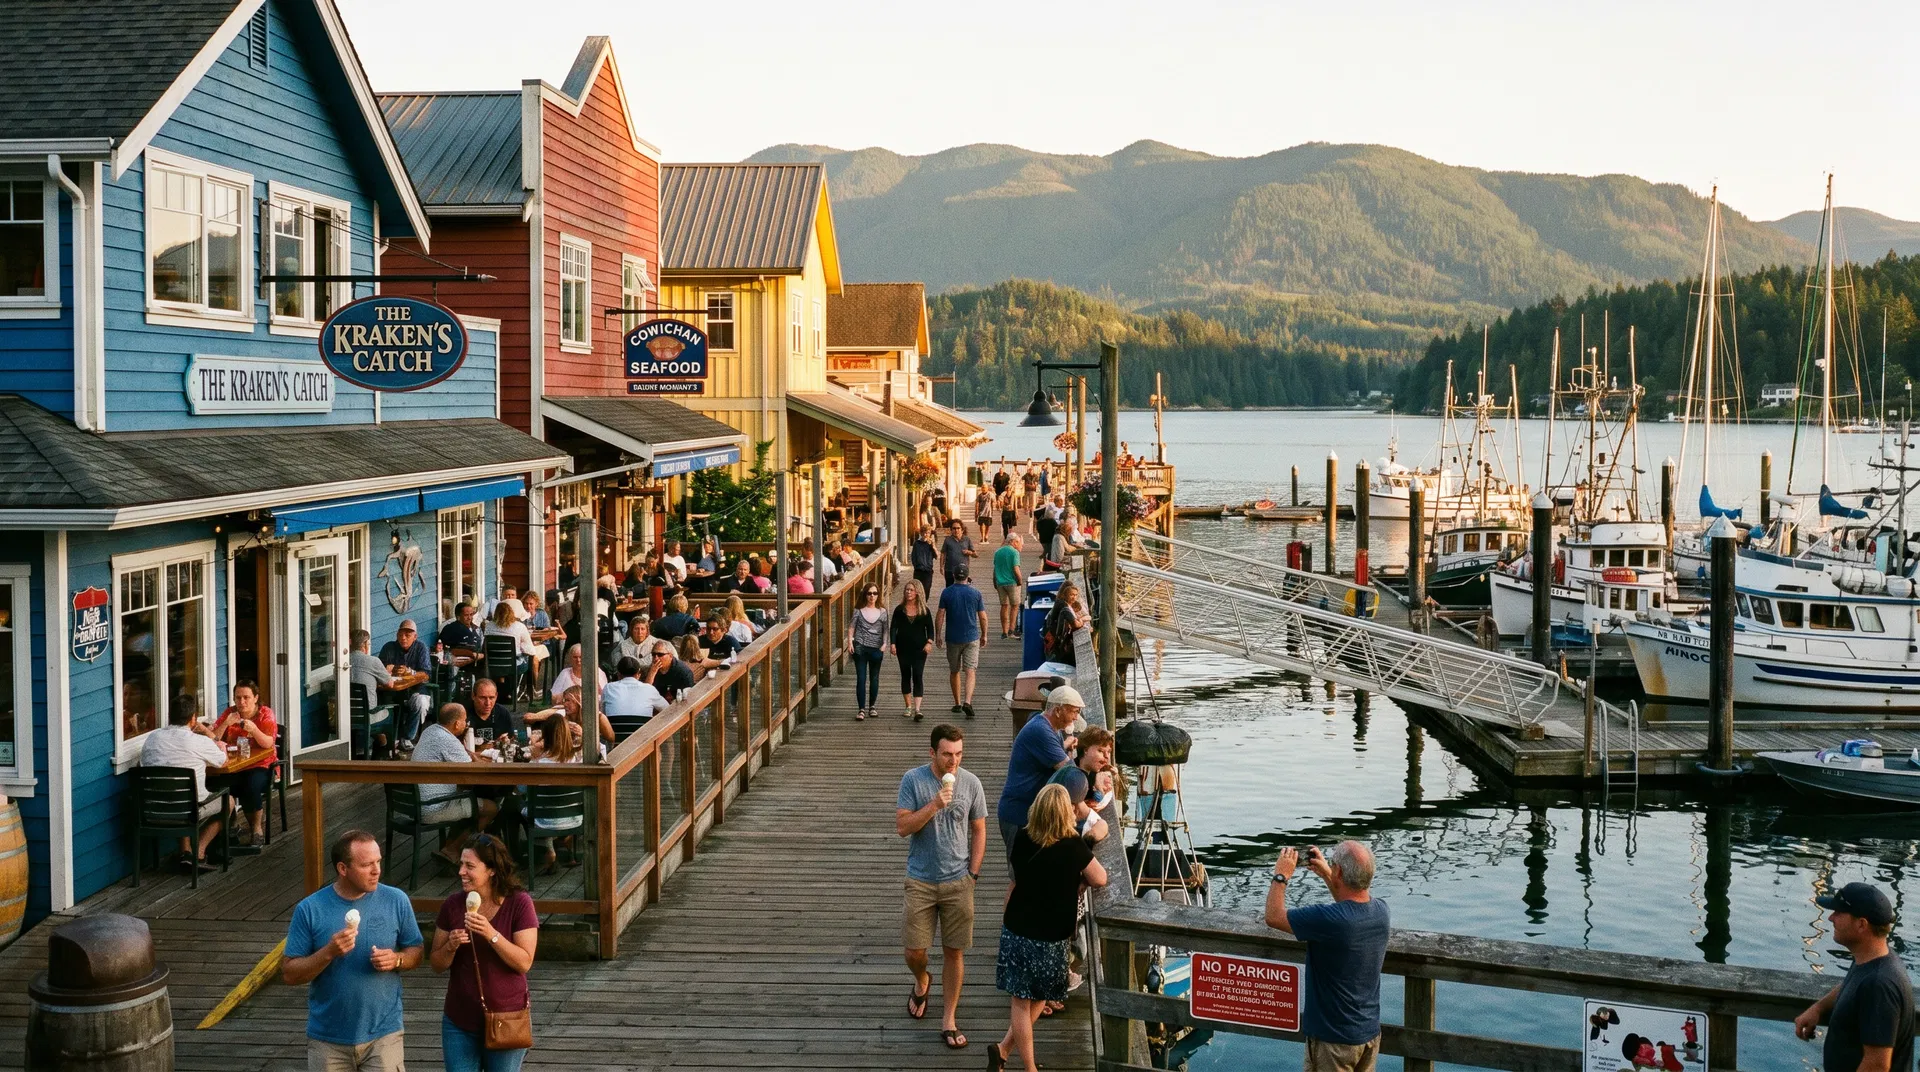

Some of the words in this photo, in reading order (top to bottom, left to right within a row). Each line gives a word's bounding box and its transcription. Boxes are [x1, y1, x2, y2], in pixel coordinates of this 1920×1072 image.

[375, 307, 411, 320] THE
[333, 322, 453, 354] KRAKEN'S
[630, 323, 701, 346] COWICHAN
[353, 351, 433, 372] CATCH
[630, 362, 701, 374] SEAFOOD
[199, 369, 226, 401] THE
[230, 370, 289, 402] KRAKEN'S
[293, 372, 328, 401] CATCH
[1201, 959, 1222, 973] NO
[1227, 963, 1291, 983] PARKING
